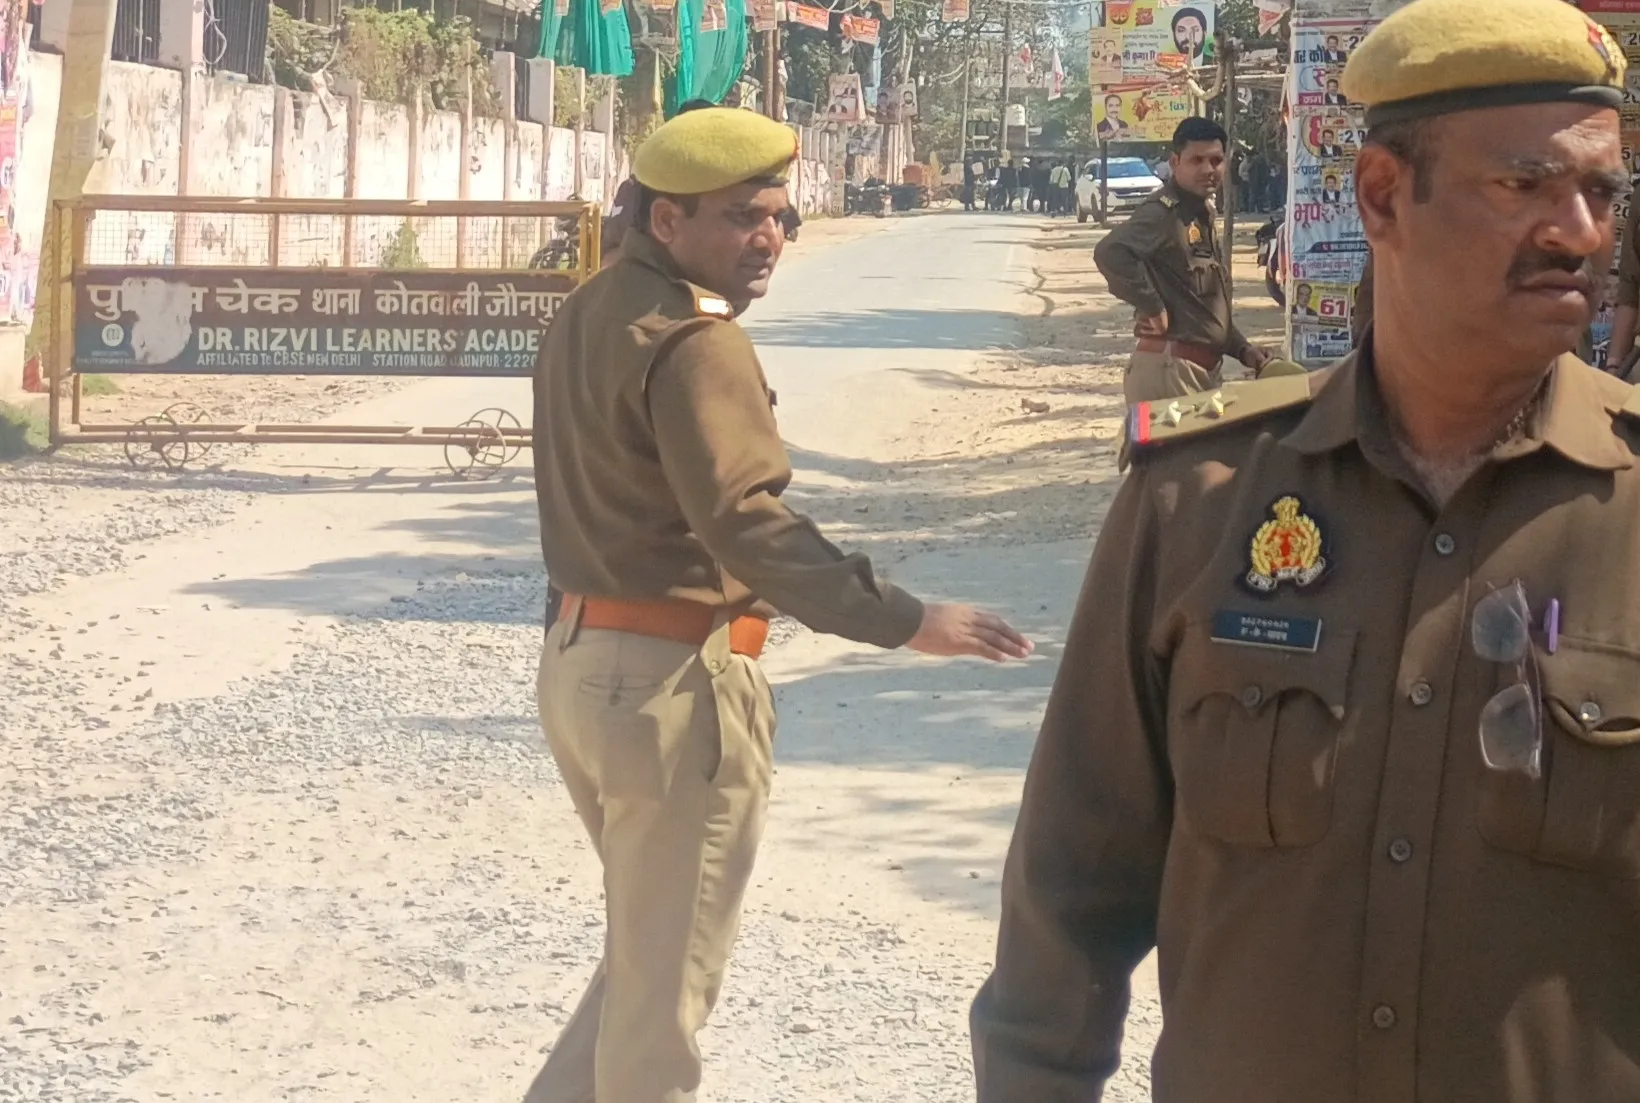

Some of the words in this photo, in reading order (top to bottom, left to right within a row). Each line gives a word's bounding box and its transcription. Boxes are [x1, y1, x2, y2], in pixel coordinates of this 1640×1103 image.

[216, 278, 301, 315] चेक
[311, 288, 361, 315] थाना
[374, 280, 482, 316] कोतवाली
[1320, 299, 1346, 316] 61
[244, 327, 318, 352] RIZVI
[464, 328, 548, 352] ACADE
[197, 353, 258, 366] AFFILIATED
[273, 351, 305, 366] CBSE
[307, 353, 329, 366] NEW
[331, 353, 360, 366] DELHI
[372, 353, 418, 368] STATION
